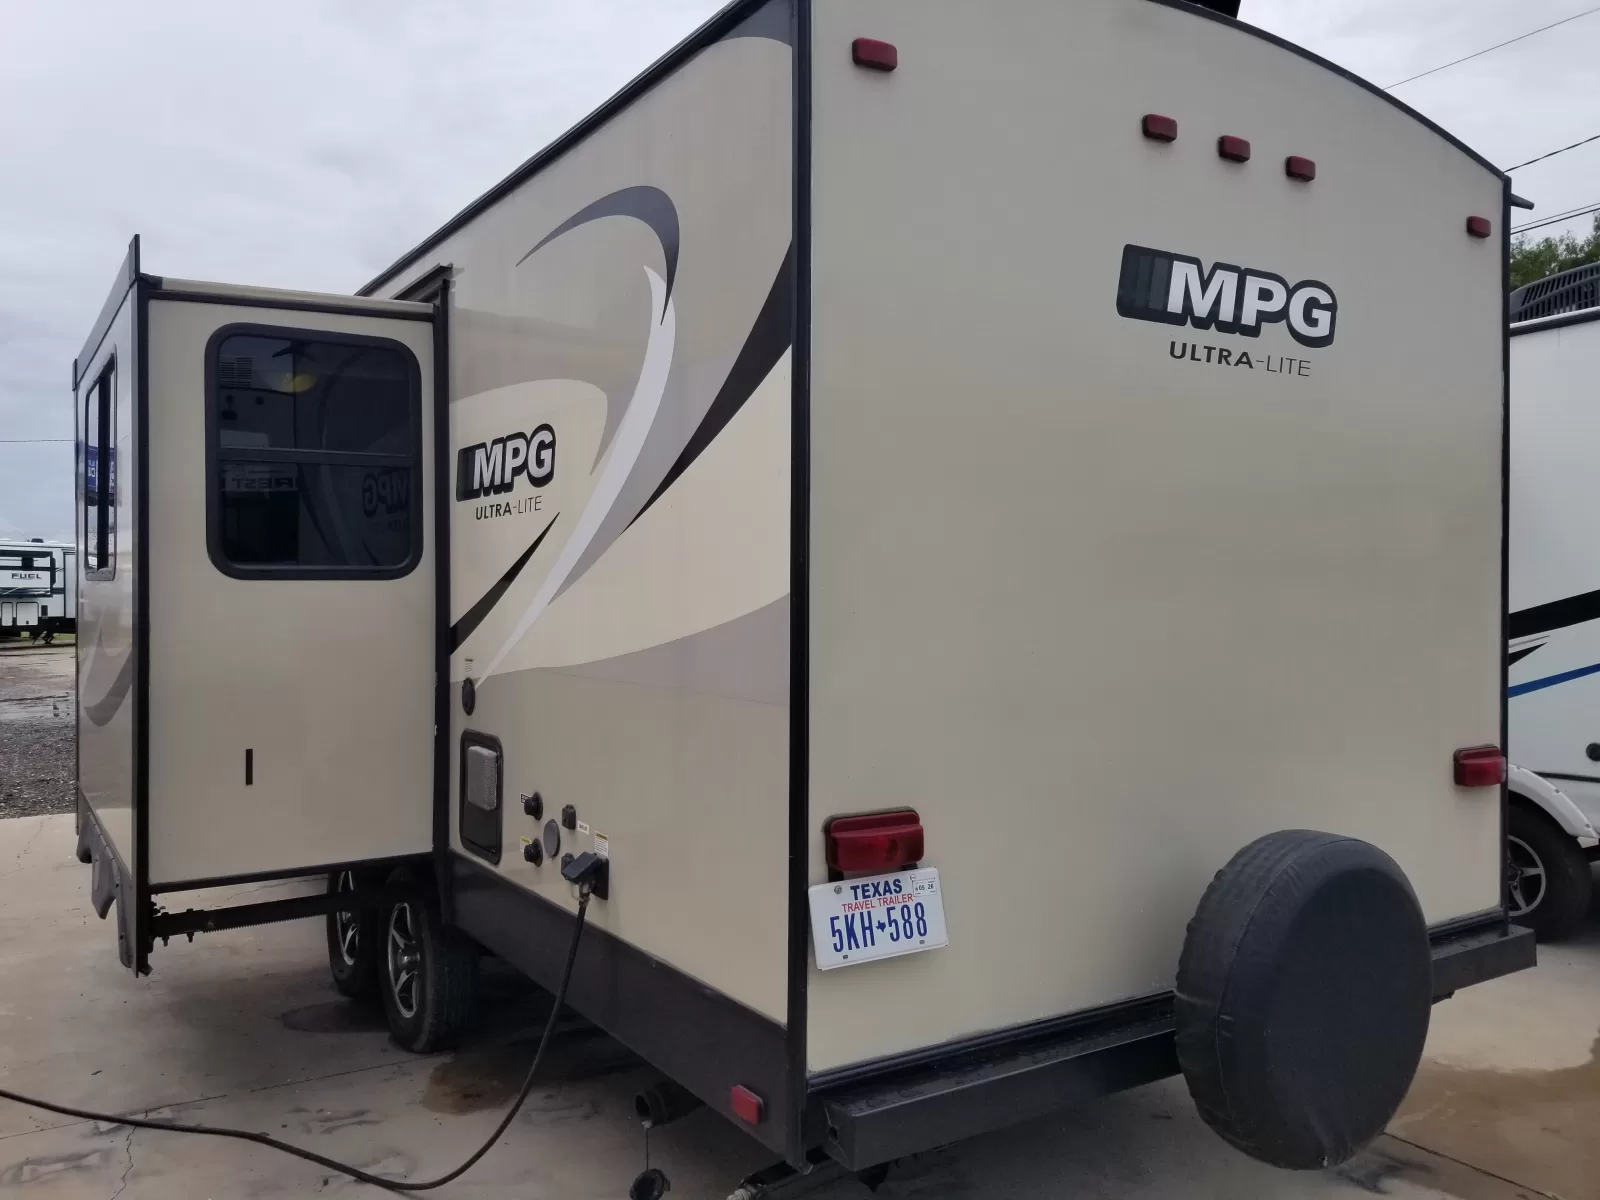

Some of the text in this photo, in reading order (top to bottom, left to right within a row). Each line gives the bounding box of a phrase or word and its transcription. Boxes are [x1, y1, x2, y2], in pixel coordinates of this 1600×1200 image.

[1166, 259, 1335, 341] MPG
[1169, 340, 1312, 377] ULTRA-LITE
[472, 429, 555, 491] MPG
[475, 495, 543, 520] ULTRA-LITE
[841, 893, 914, 914] TRAVEL TRAILER
[850, 878, 903, 901] TEXAS
